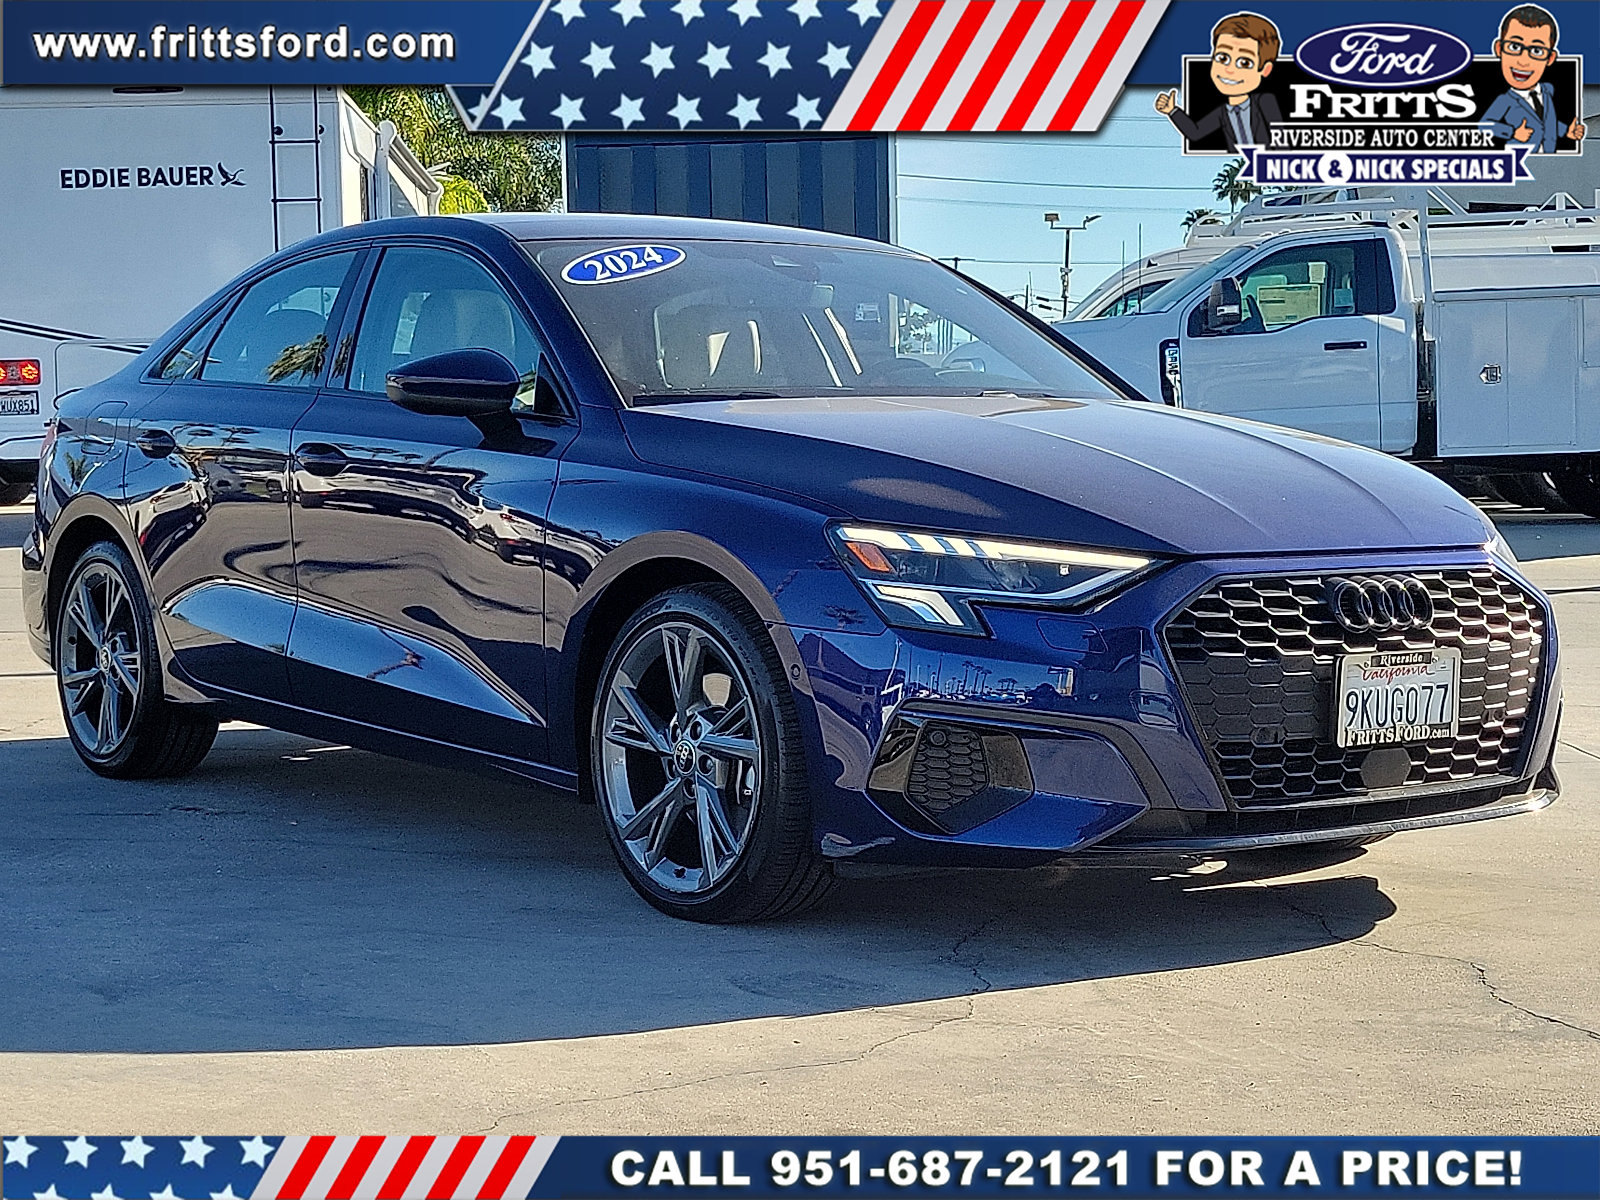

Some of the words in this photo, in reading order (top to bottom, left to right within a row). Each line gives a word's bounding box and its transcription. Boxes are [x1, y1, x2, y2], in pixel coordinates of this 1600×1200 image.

[60, 169, 130, 189] EDDIE
[136, 166, 214, 187] BAUER
[584, 247, 664, 281] 2024
[1379, 653, 1424, 665] Riverside
[1362, 665, 1436, 684] California
[1345, 684, 1449, 729] 9KUG077
